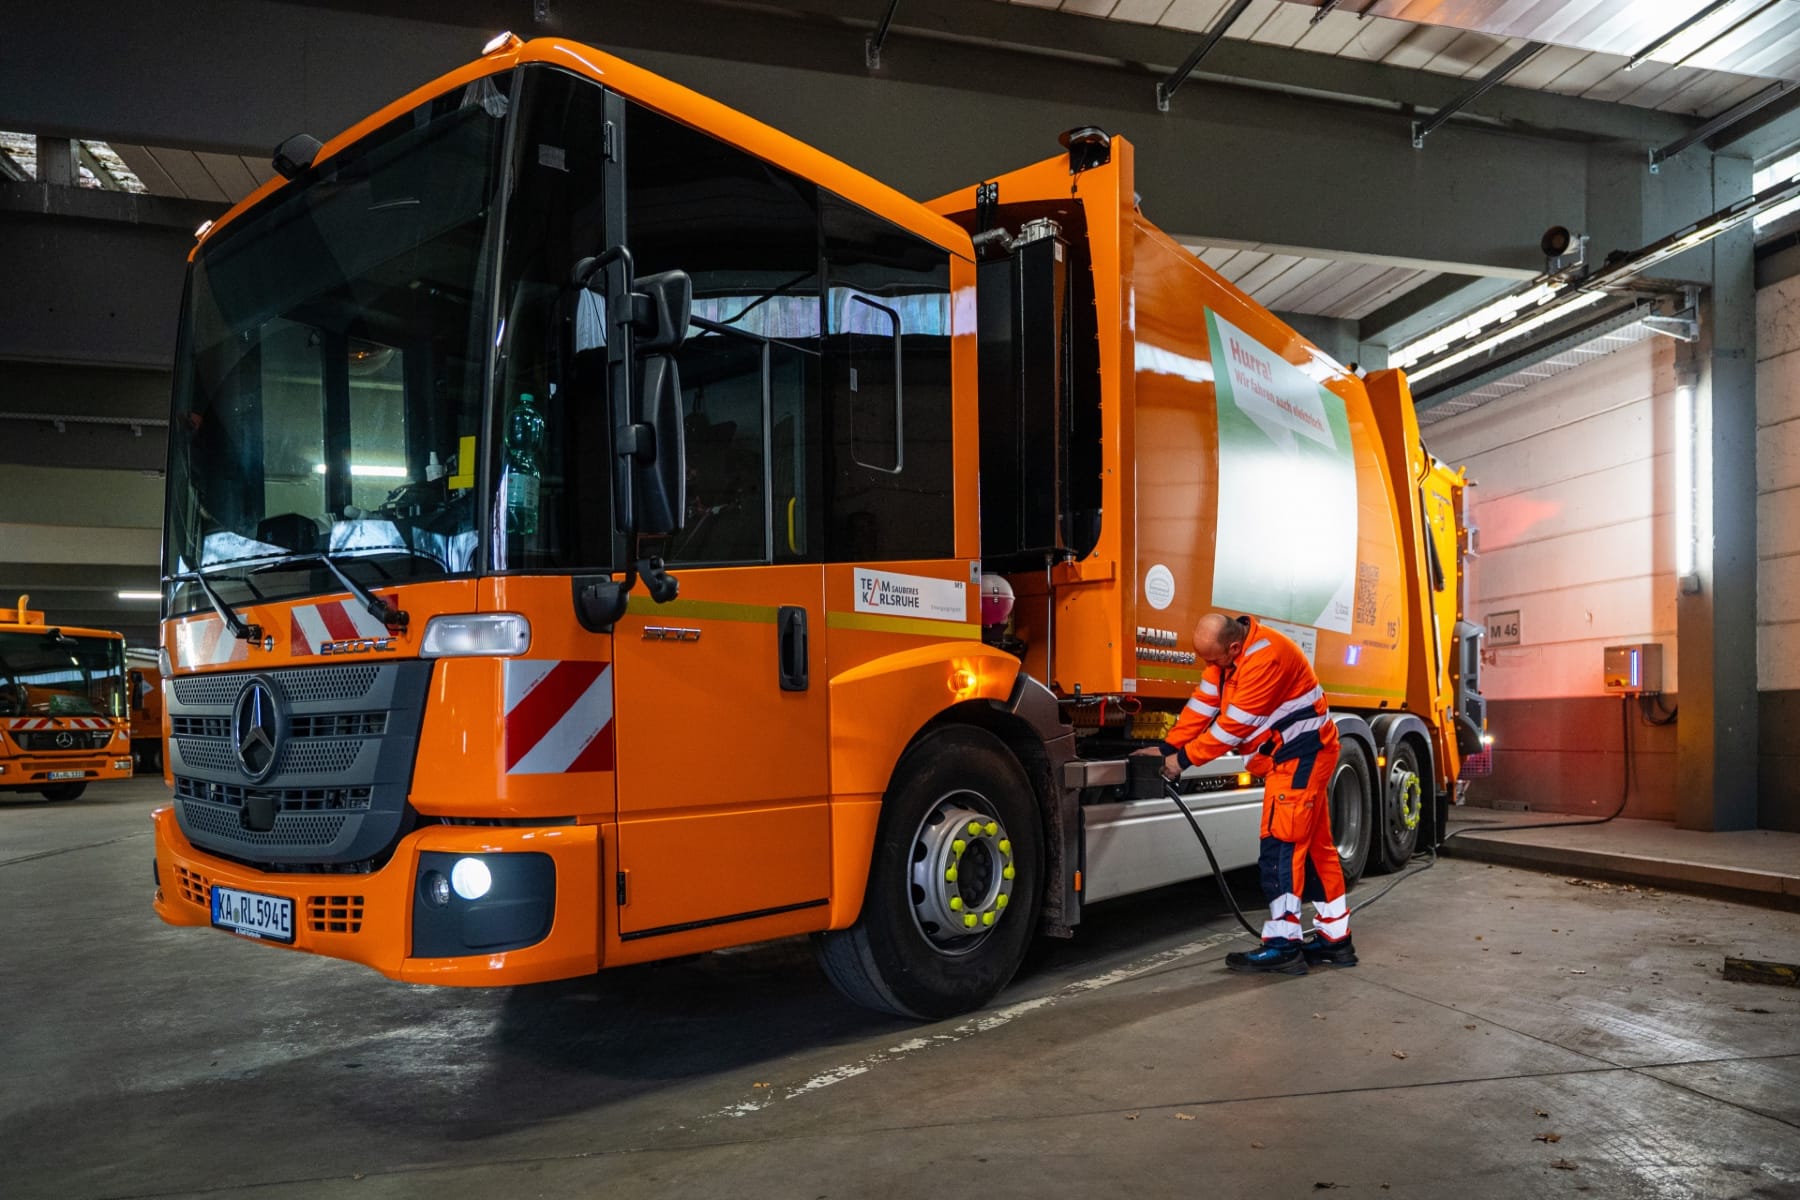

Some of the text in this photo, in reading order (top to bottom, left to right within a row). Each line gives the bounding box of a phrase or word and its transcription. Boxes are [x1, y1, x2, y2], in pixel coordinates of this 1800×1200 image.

[1229, 337, 1272, 383] Hurra!
[1235, 367, 1249, 388] Wir
[1251, 378, 1275, 403] fahren
[1276, 397, 1293, 414] auch
[891, 585, 919, 596] SAUBERES
[1490, 624, 1518, 638] M 46
[219, 893, 289, 931] KA RL 594E
